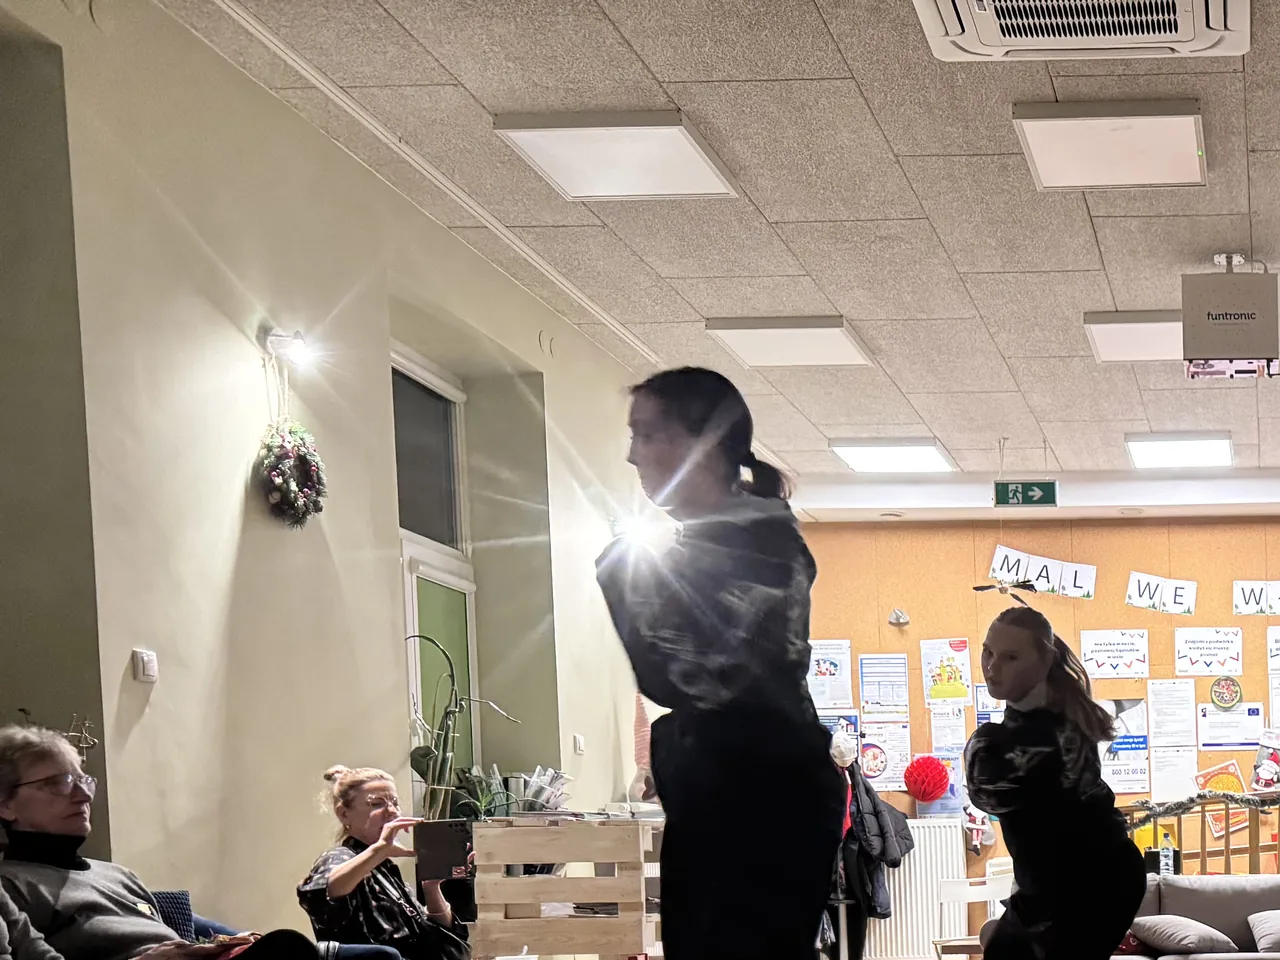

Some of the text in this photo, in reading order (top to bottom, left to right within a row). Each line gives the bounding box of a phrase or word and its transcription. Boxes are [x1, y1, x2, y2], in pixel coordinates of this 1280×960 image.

[1207, 311, 1256, 321] funtronic
[999, 553, 1083, 590] MAL
[1136, 578, 1185, 606] WE
